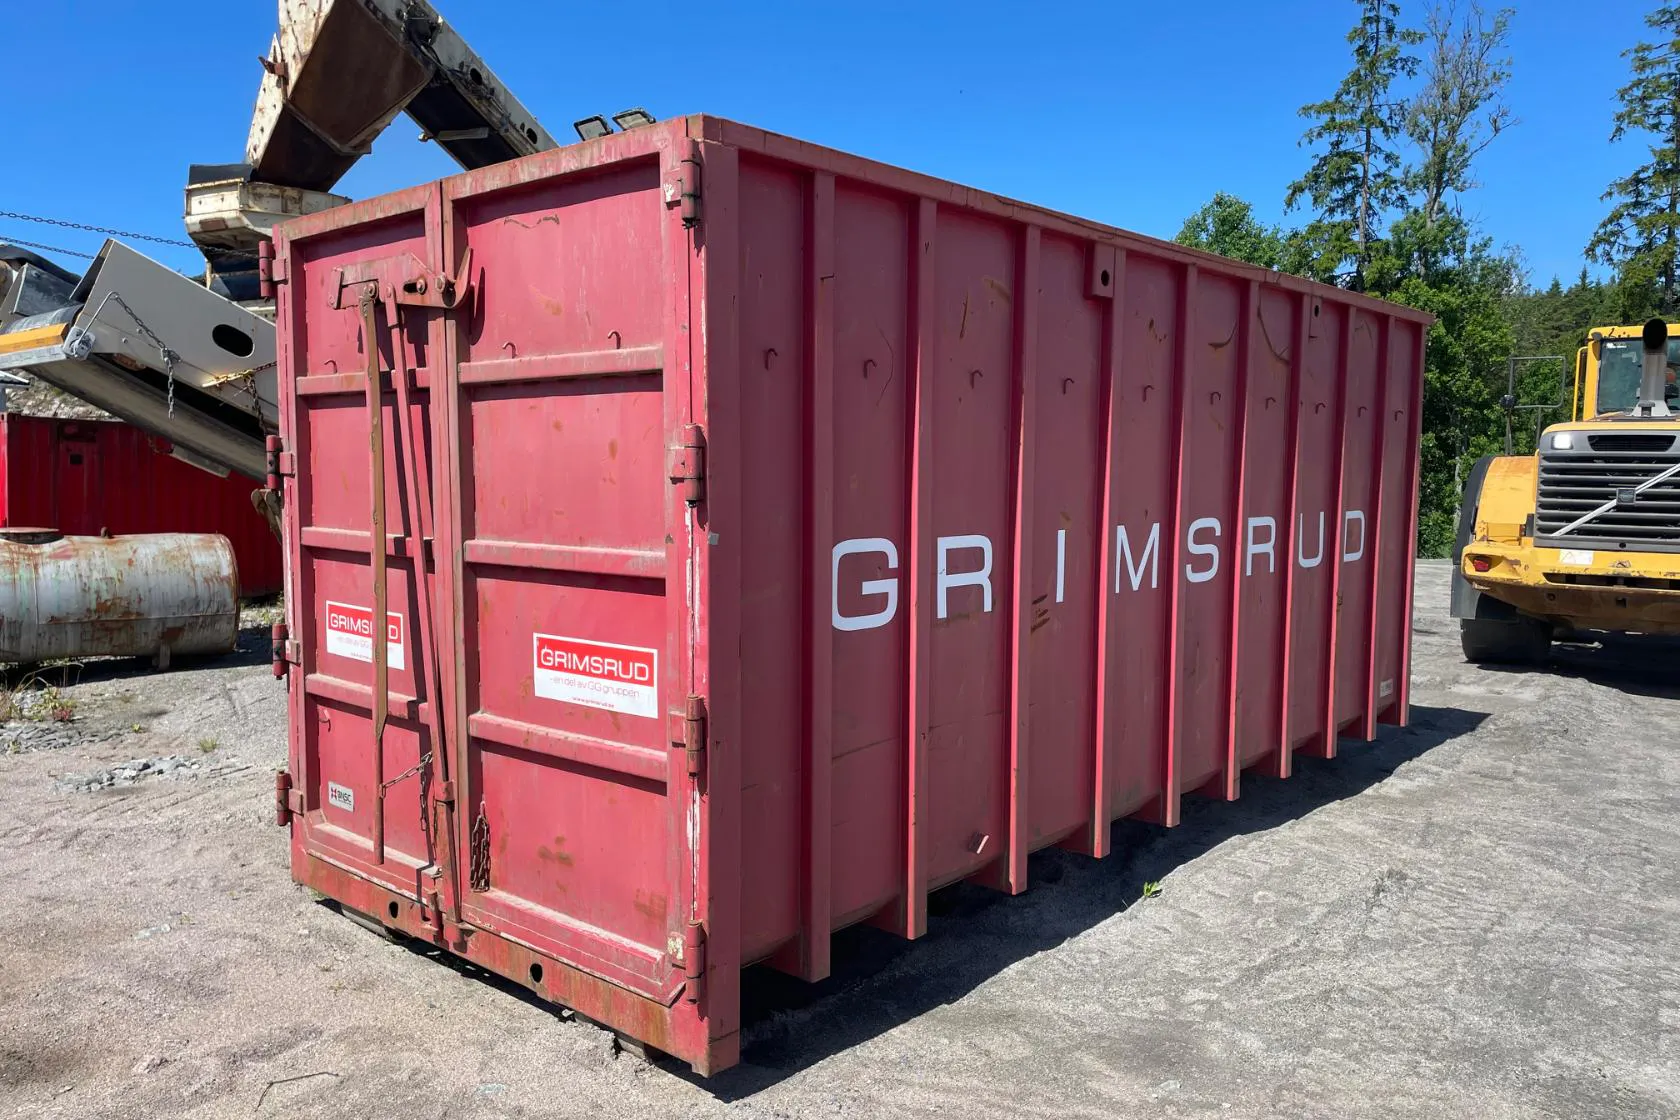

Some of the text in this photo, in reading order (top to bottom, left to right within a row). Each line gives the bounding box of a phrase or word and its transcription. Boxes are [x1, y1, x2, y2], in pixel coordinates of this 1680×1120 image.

[832, 510, 1365, 631] GRIMSRUD
[330, 613, 398, 640] GRIMSD
[541, 645, 649, 681] GRIMSRUD
